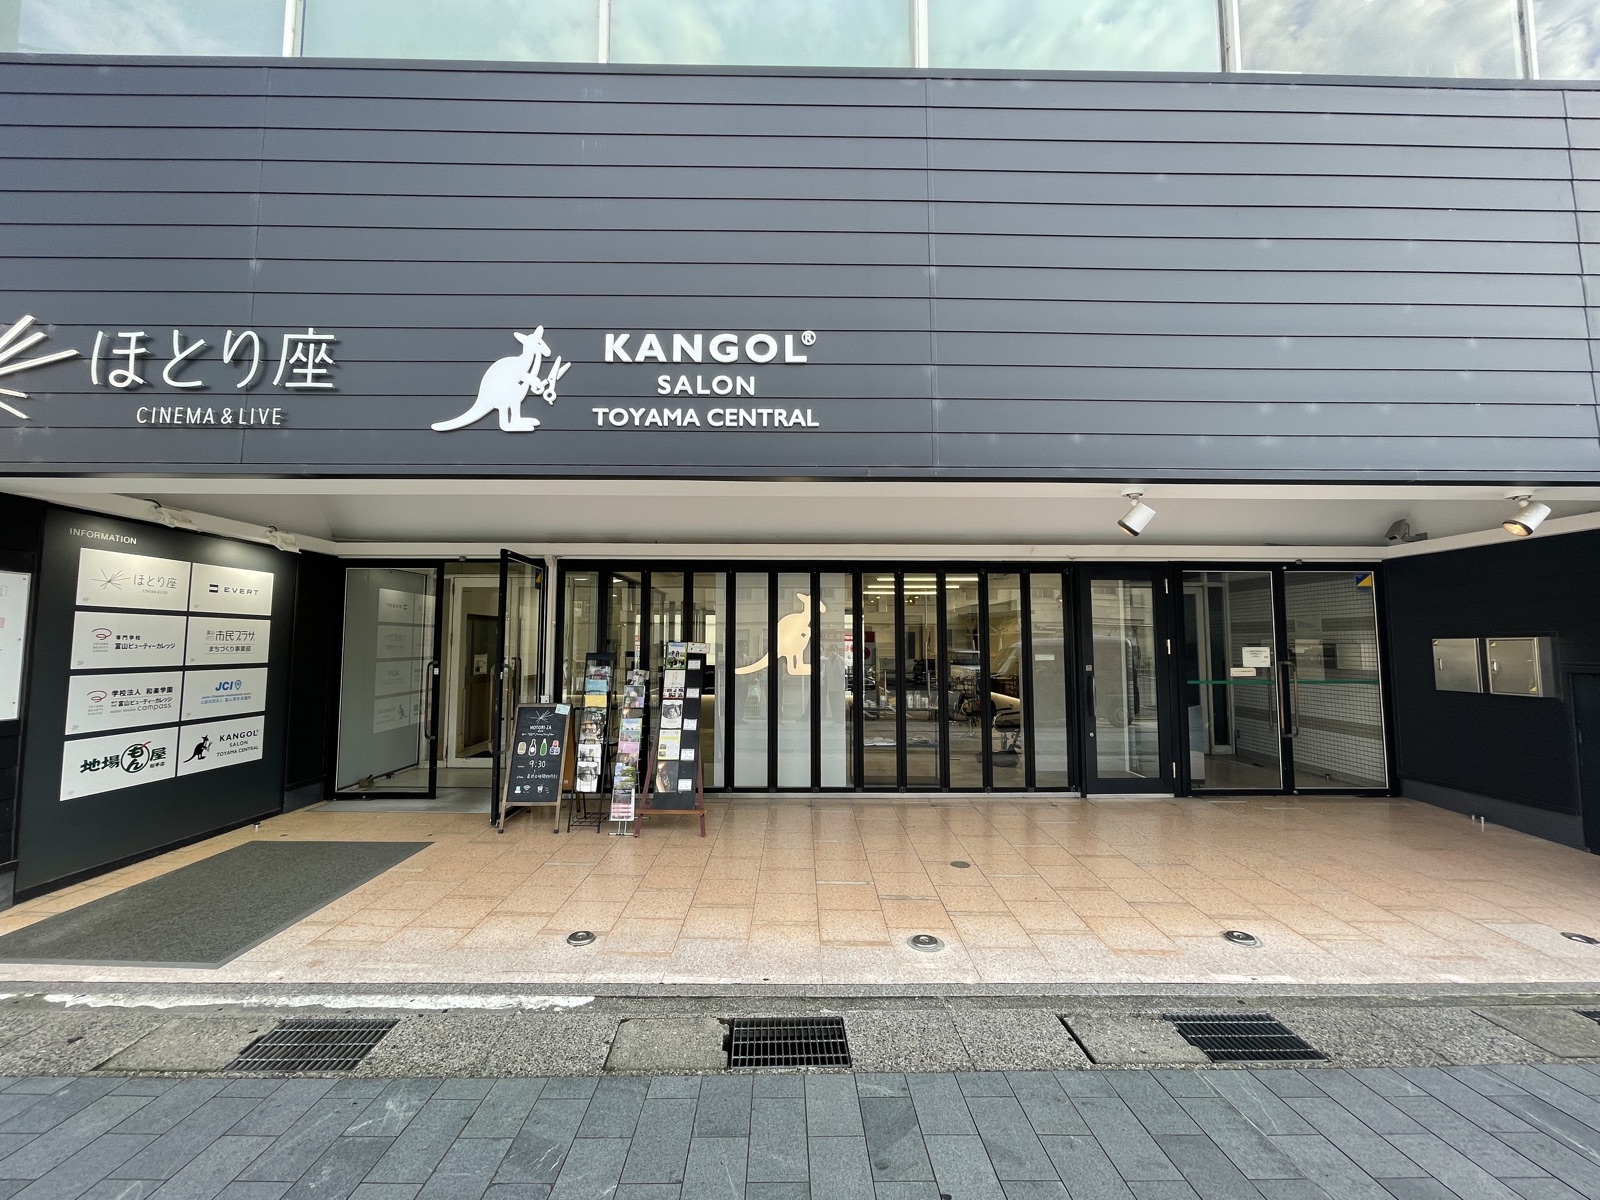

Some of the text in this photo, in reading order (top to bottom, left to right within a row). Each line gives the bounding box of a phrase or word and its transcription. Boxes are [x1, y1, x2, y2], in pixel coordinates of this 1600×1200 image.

[91, 327, 336, 389] ほとり座
[657, 375, 756, 396] SALON
[136, 406, 282, 426] CINEMA & LIVE
[592, 407, 820, 428] TOYAMA CENTRAL
[69, 527, 138, 546] INFORMATION
[133, 573, 178, 590] ほとり座
[224, 586, 260, 596] EVERT
[215, 630, 256, 642] 市民プラザ
[114, 642, 176, 650] 富山ビューティーカレッジ
[215, 681, 233, 692] JCI
[111, 688, 141, 698] 学校法人
[118, 696, 173, 707] 富山ビューティーカレッジ
[137, 702, 172, 712] compass
[229, 740, 249, 748] SALON
[216, 745, 259, 758] TOYAMA CENTRAL
[529, 760, 546, 769] 9:30
